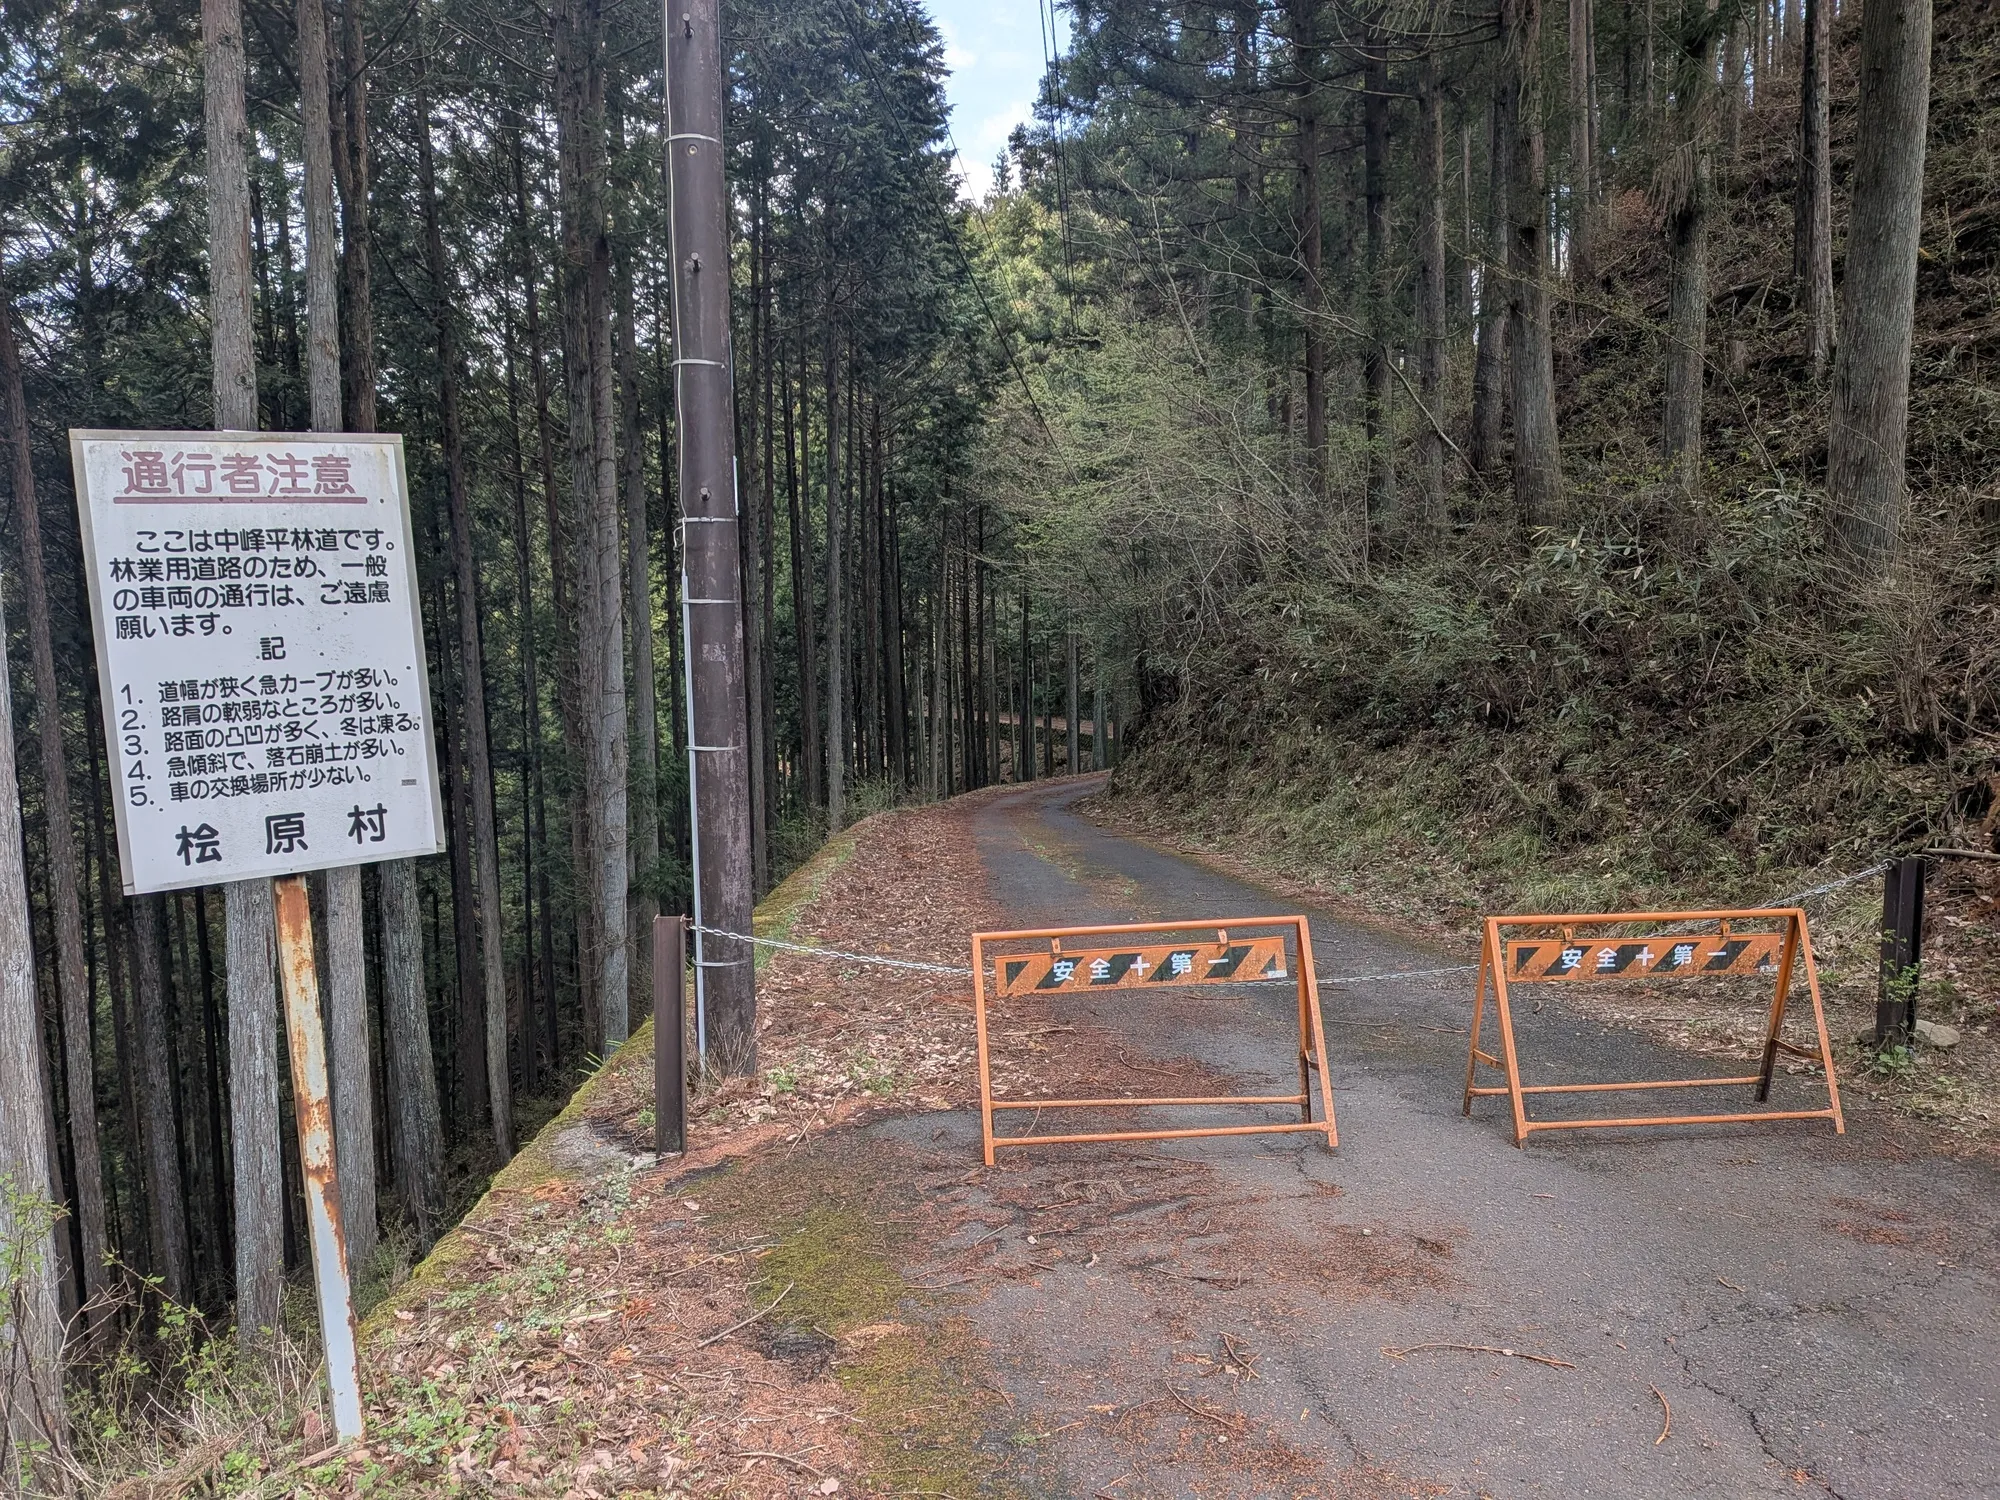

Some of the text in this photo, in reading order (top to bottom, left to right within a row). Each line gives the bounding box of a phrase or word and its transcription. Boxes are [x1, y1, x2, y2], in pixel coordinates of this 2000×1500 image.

[121, 451, 357, 495] 通行者注意
[136, 528, 395, 553] ここは中峰平林道です。
[109, 554, 389, 582] 林業用道路のため、一般
[112, 580, 391, 612] の車両の通行は、ご遠慮
[115, 611, 232, 640] 願います。
[260, 637, 286, 660] 記
[120, 668, 398, 704] 1. 道幅が狭く急カーブが多い。
[122, 692, 400, 730] 2. 路肩の軟弱なところが多い。
[124, 713, 420, 755] 3. 路面の凸凹が多く、冬は凍る。
[127, 738, 405, 781] 4. 急傾斜で、落石崩土が多い。
[130, 765, 371, 806] 5. 車の交換場所が少ない。
